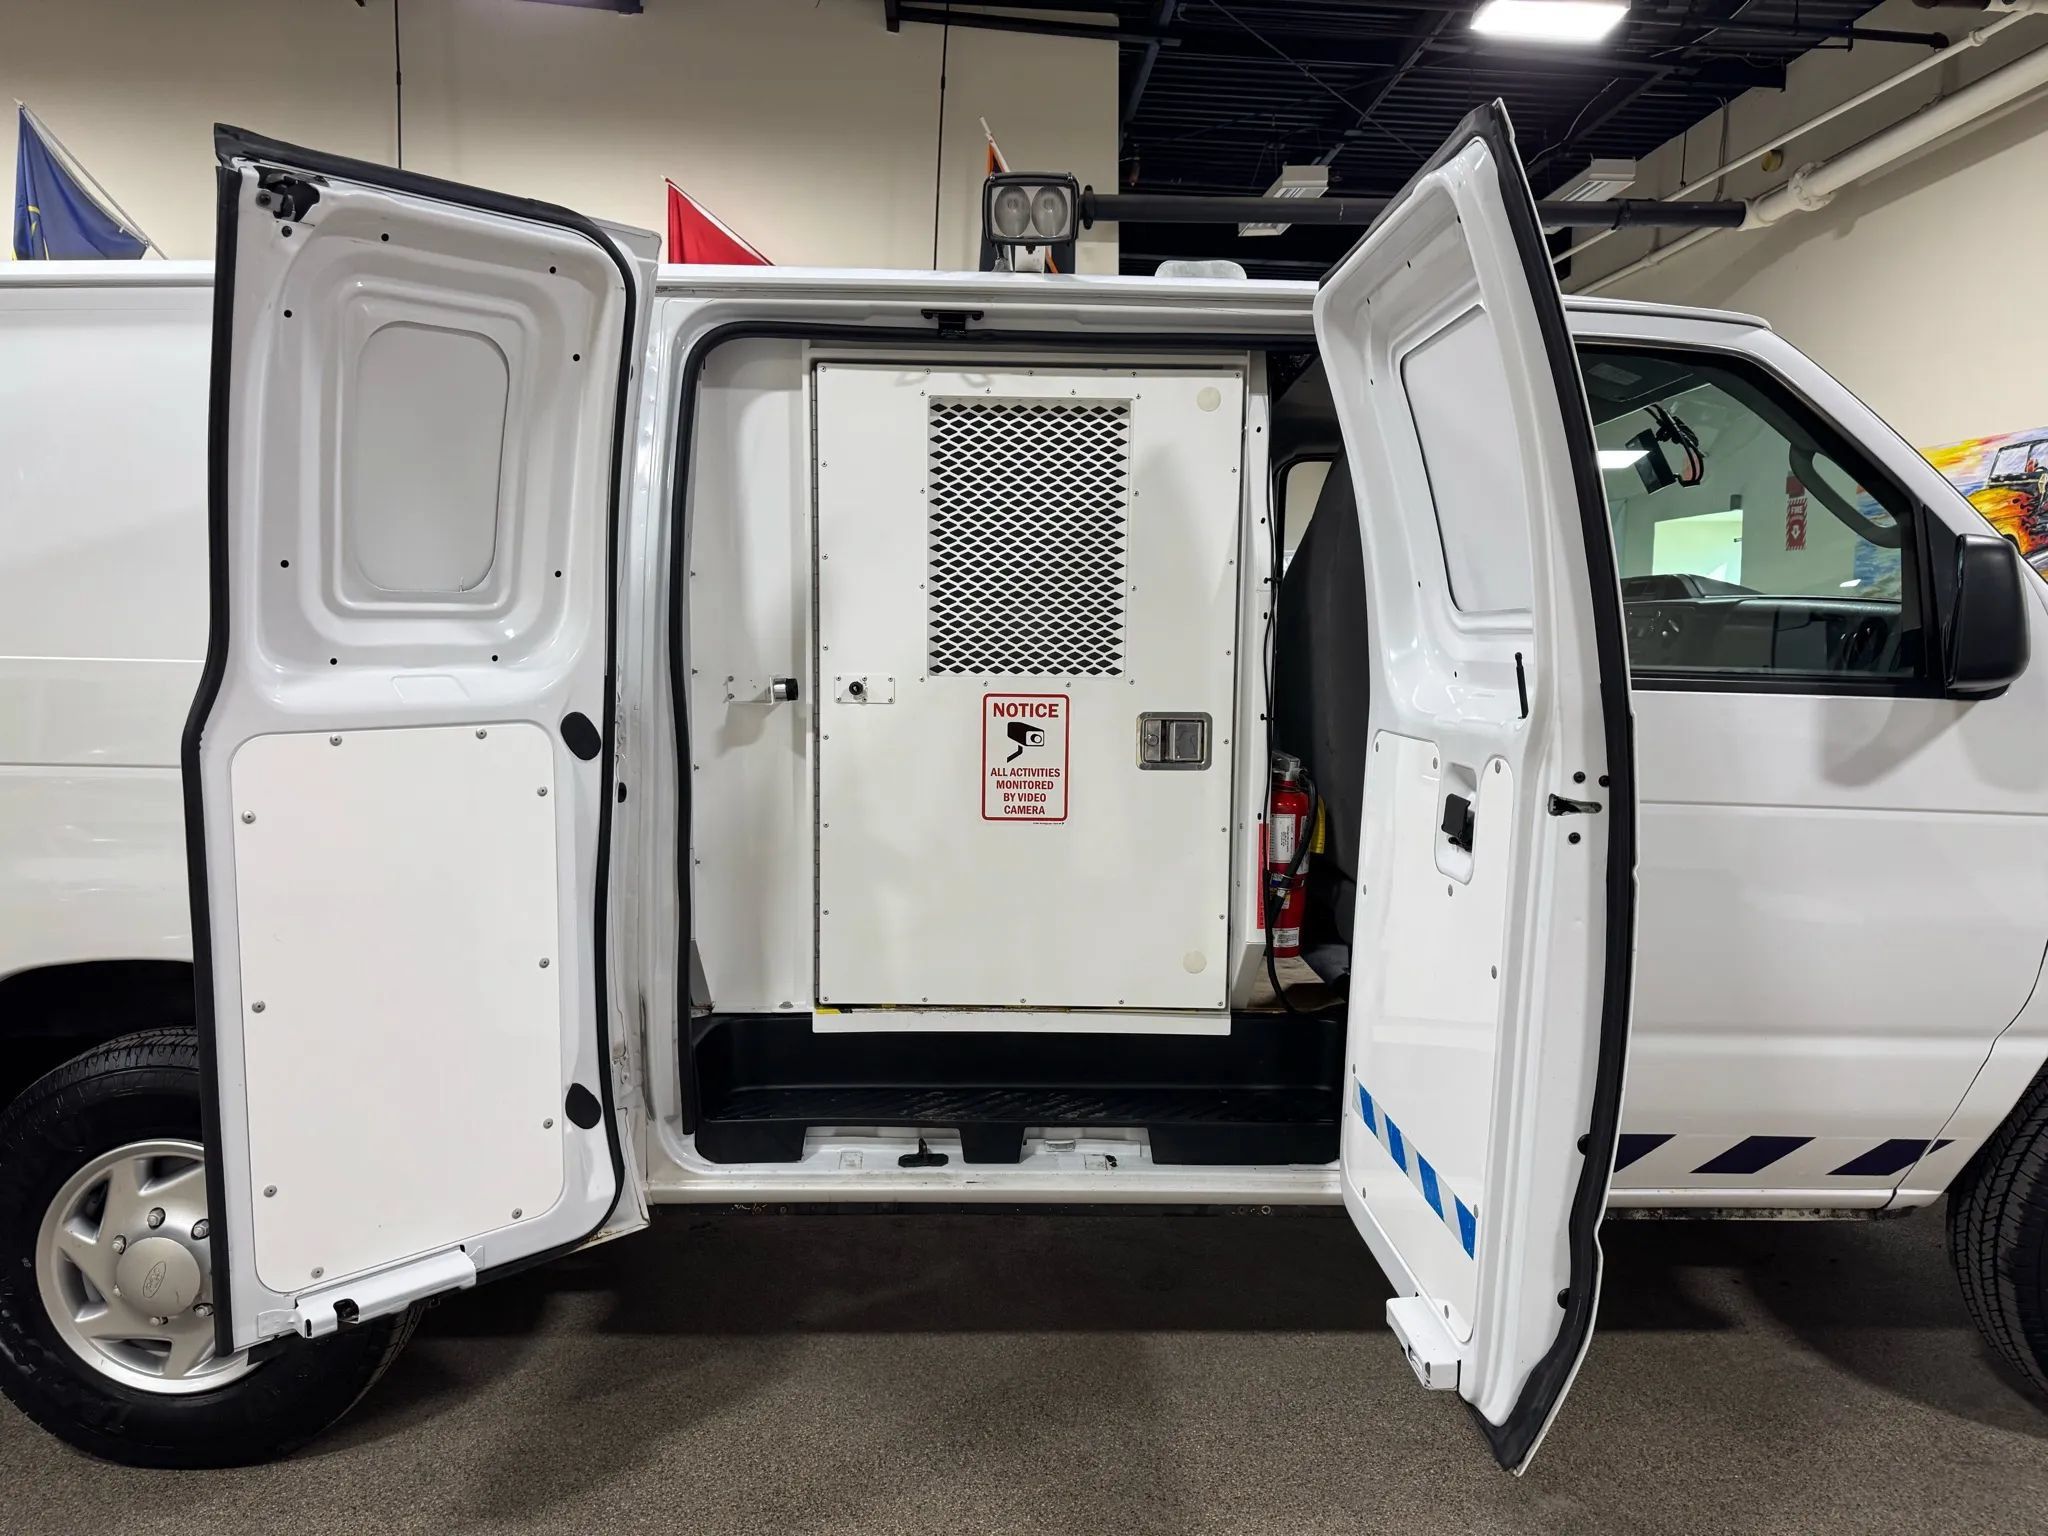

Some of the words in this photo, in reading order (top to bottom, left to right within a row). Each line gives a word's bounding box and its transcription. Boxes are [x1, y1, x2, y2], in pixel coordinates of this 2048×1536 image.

[993, 703, 1059, 718] NOTICE
[990, 767, 1008, 777] ALL
[1009, 767, 1061, 778] ACTIVITIES
[996, 780, 1054, 790] MONITORED
[1003, 792, 1016, 802] BY
[1017, 793, 1047, 802] VIDEO
[1004, 805, 1046, 815] CAMERA
